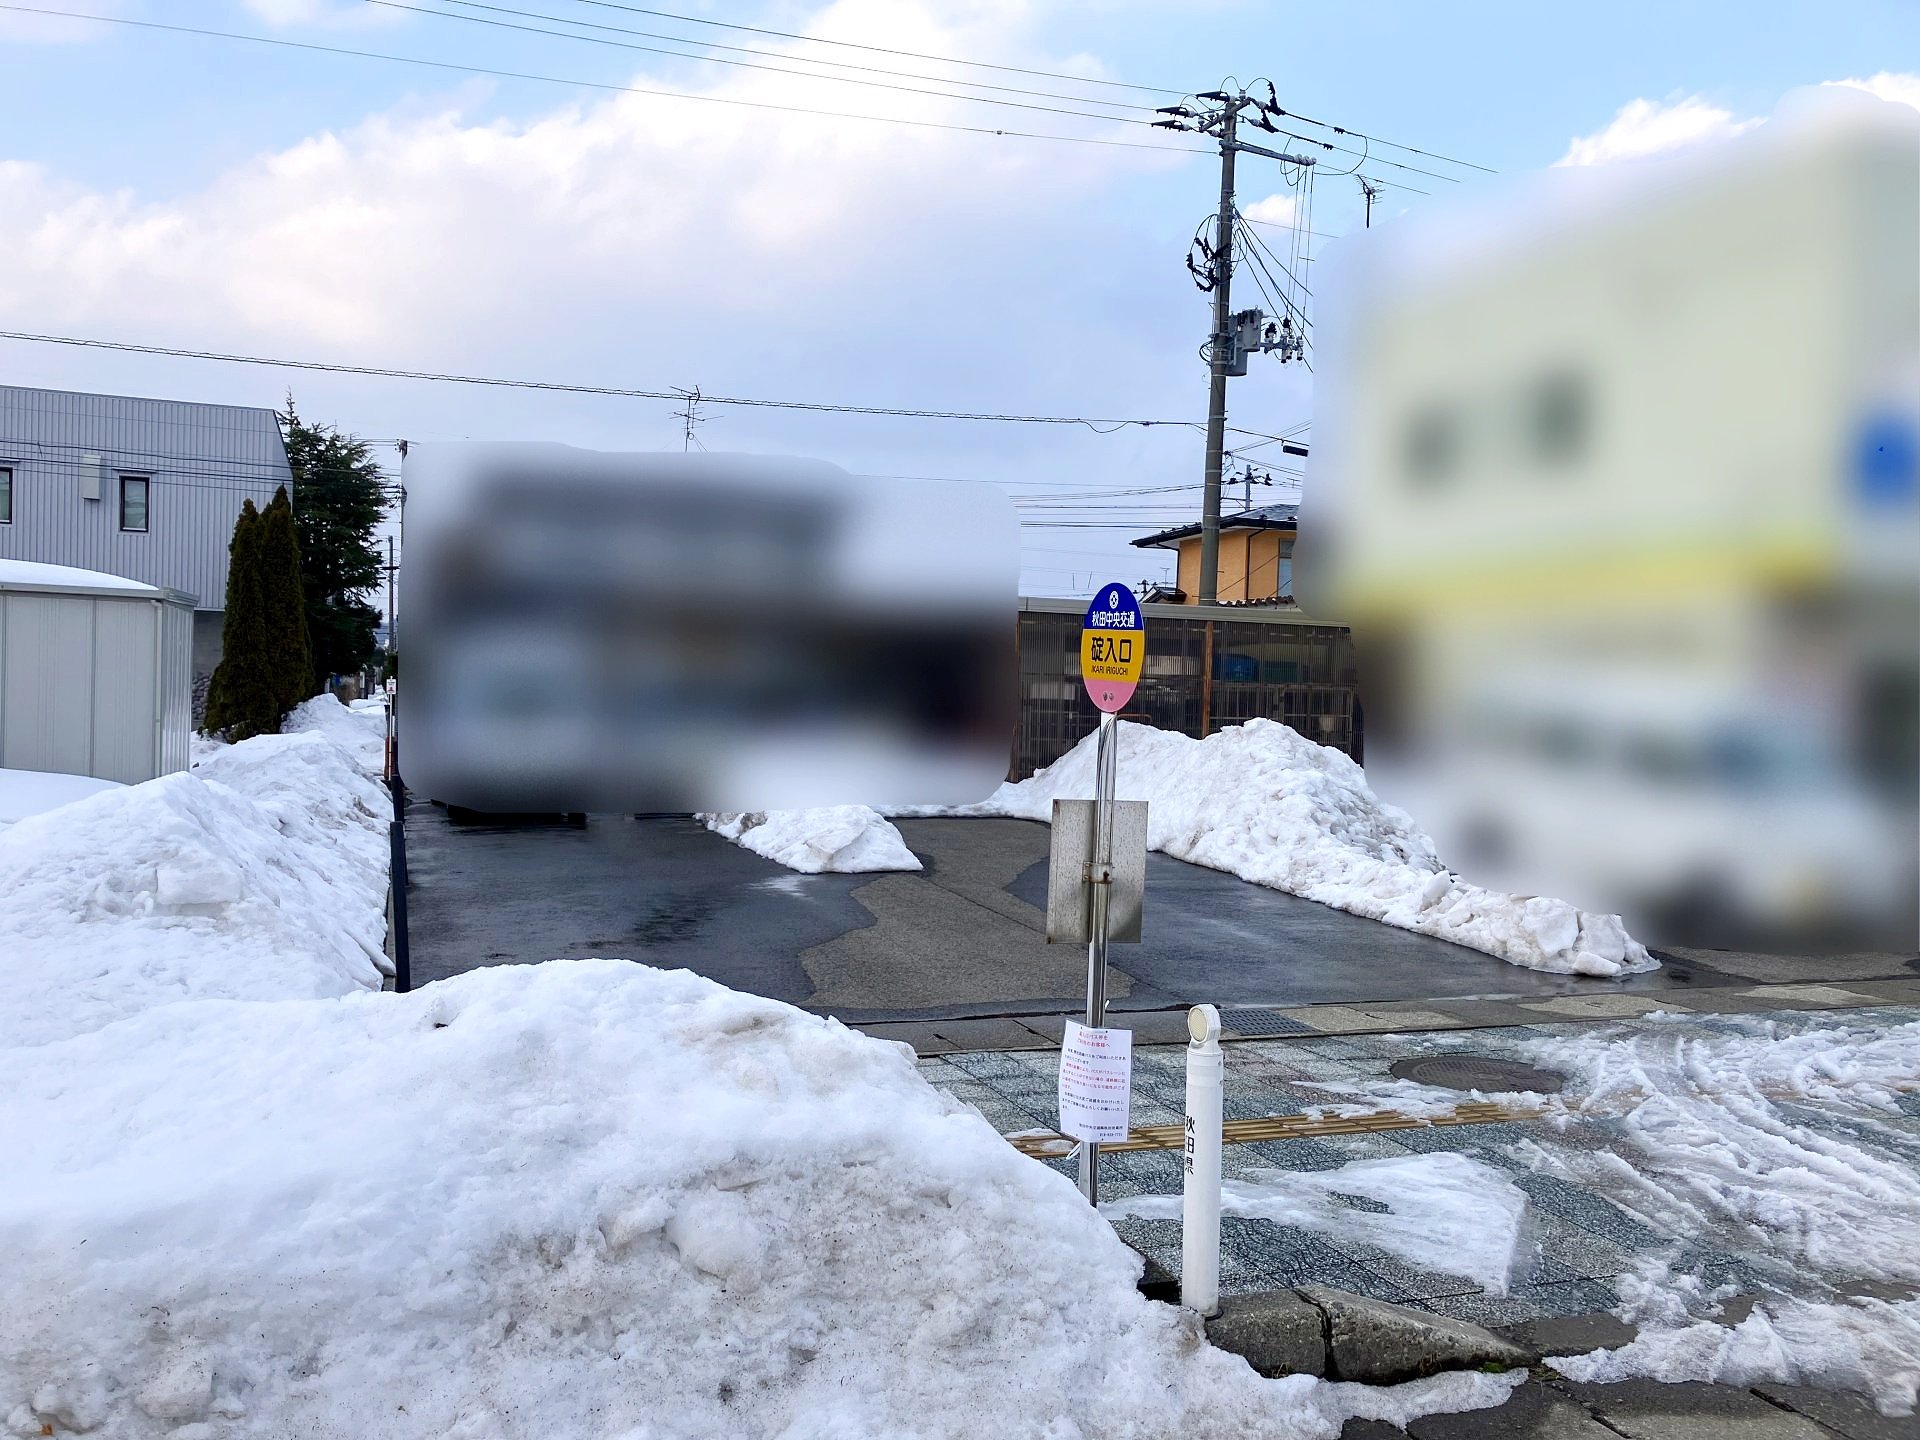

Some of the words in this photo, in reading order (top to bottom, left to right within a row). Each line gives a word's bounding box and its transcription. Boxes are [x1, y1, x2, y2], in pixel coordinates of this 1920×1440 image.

[1092, 610, 1135, 628] 秋田中央交通
[1091, 636, 1132, 663] 碇入口
[1092, 665, 1104, 674] IKARI
[1105, 666, 1128, 675] IRIGUCHI
